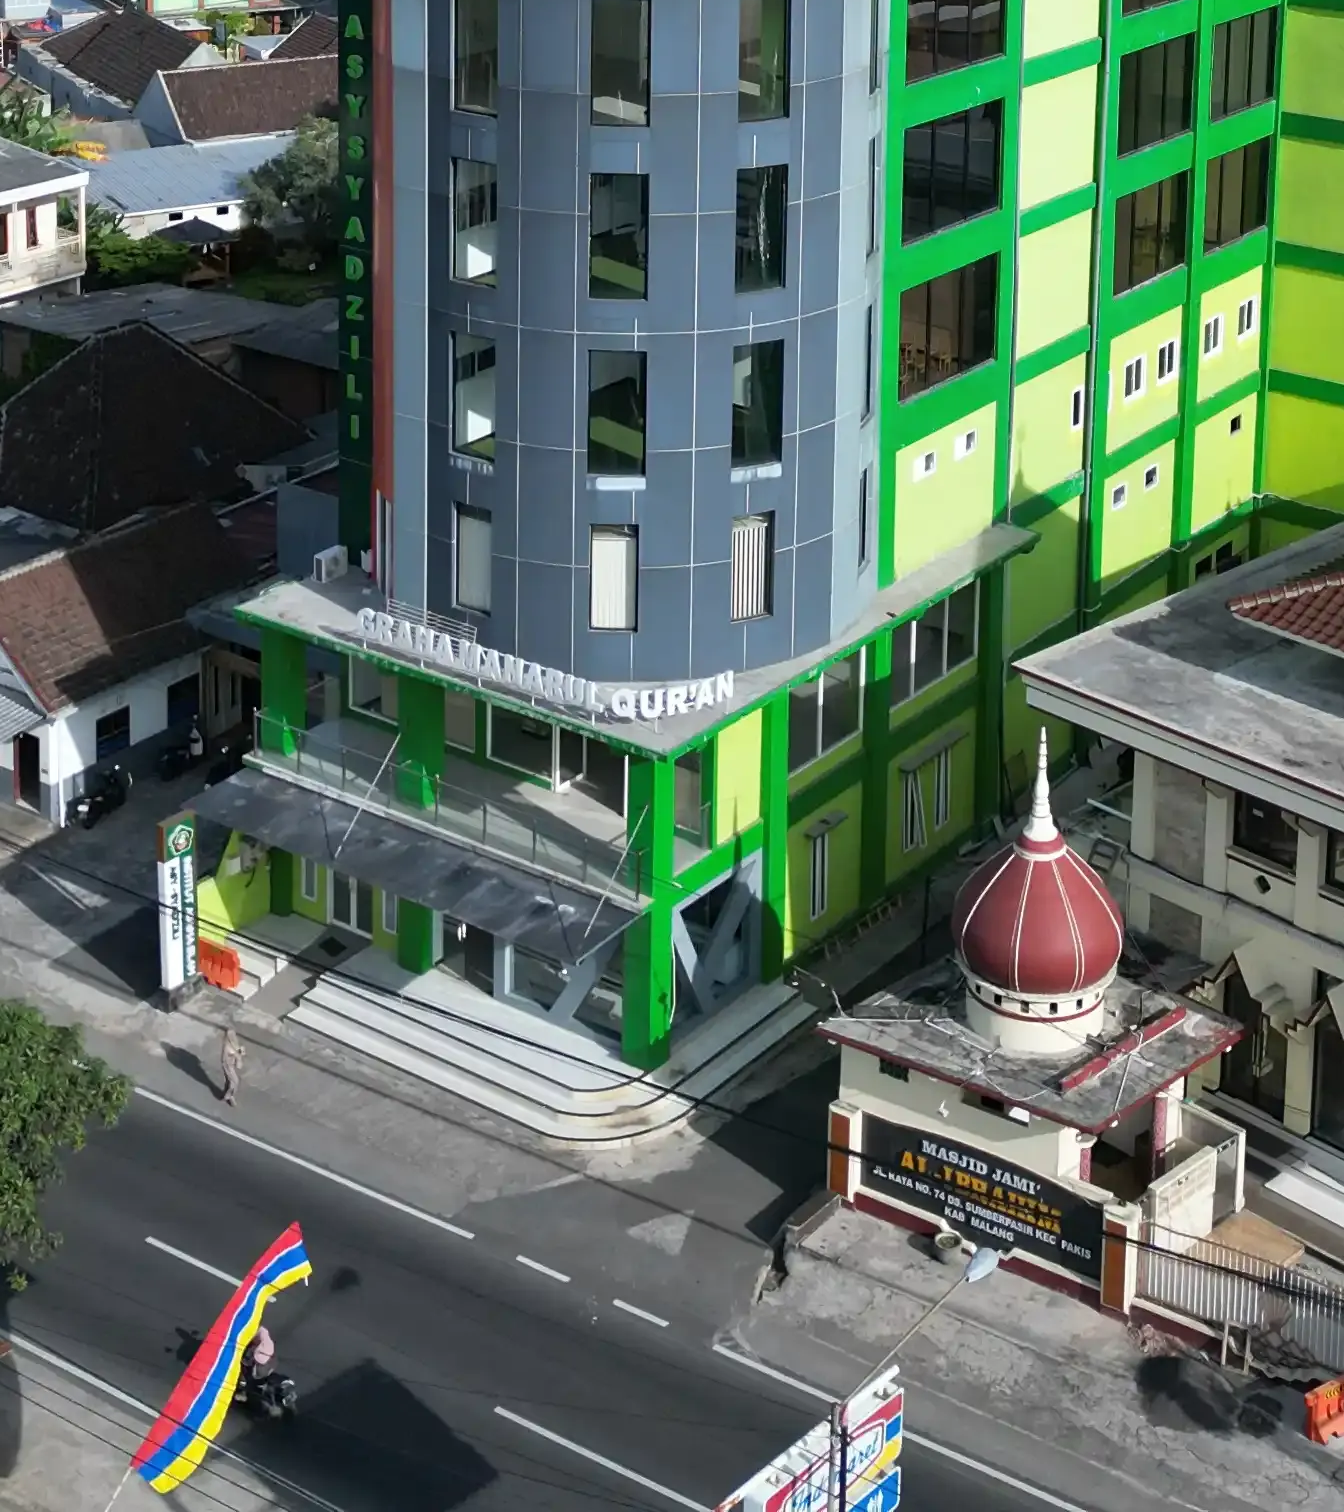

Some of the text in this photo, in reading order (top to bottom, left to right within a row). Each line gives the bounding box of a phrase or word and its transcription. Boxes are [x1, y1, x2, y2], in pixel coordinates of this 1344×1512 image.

[344, 14, 365, 439] ASYSYADZILI
[356, 607, 735, 721] GRAHA MANARUL QUR'AN
[921, 1140, 1042, 1195] MASJID JAMI'
[933, 1188, 946, 1201] 74
[965, 1201, 1034, 1237] SUMBERPASIR
[1061, 1239, 1092, 1260] PAKIS
[970, 1216, 1015, 1242] MALANG
